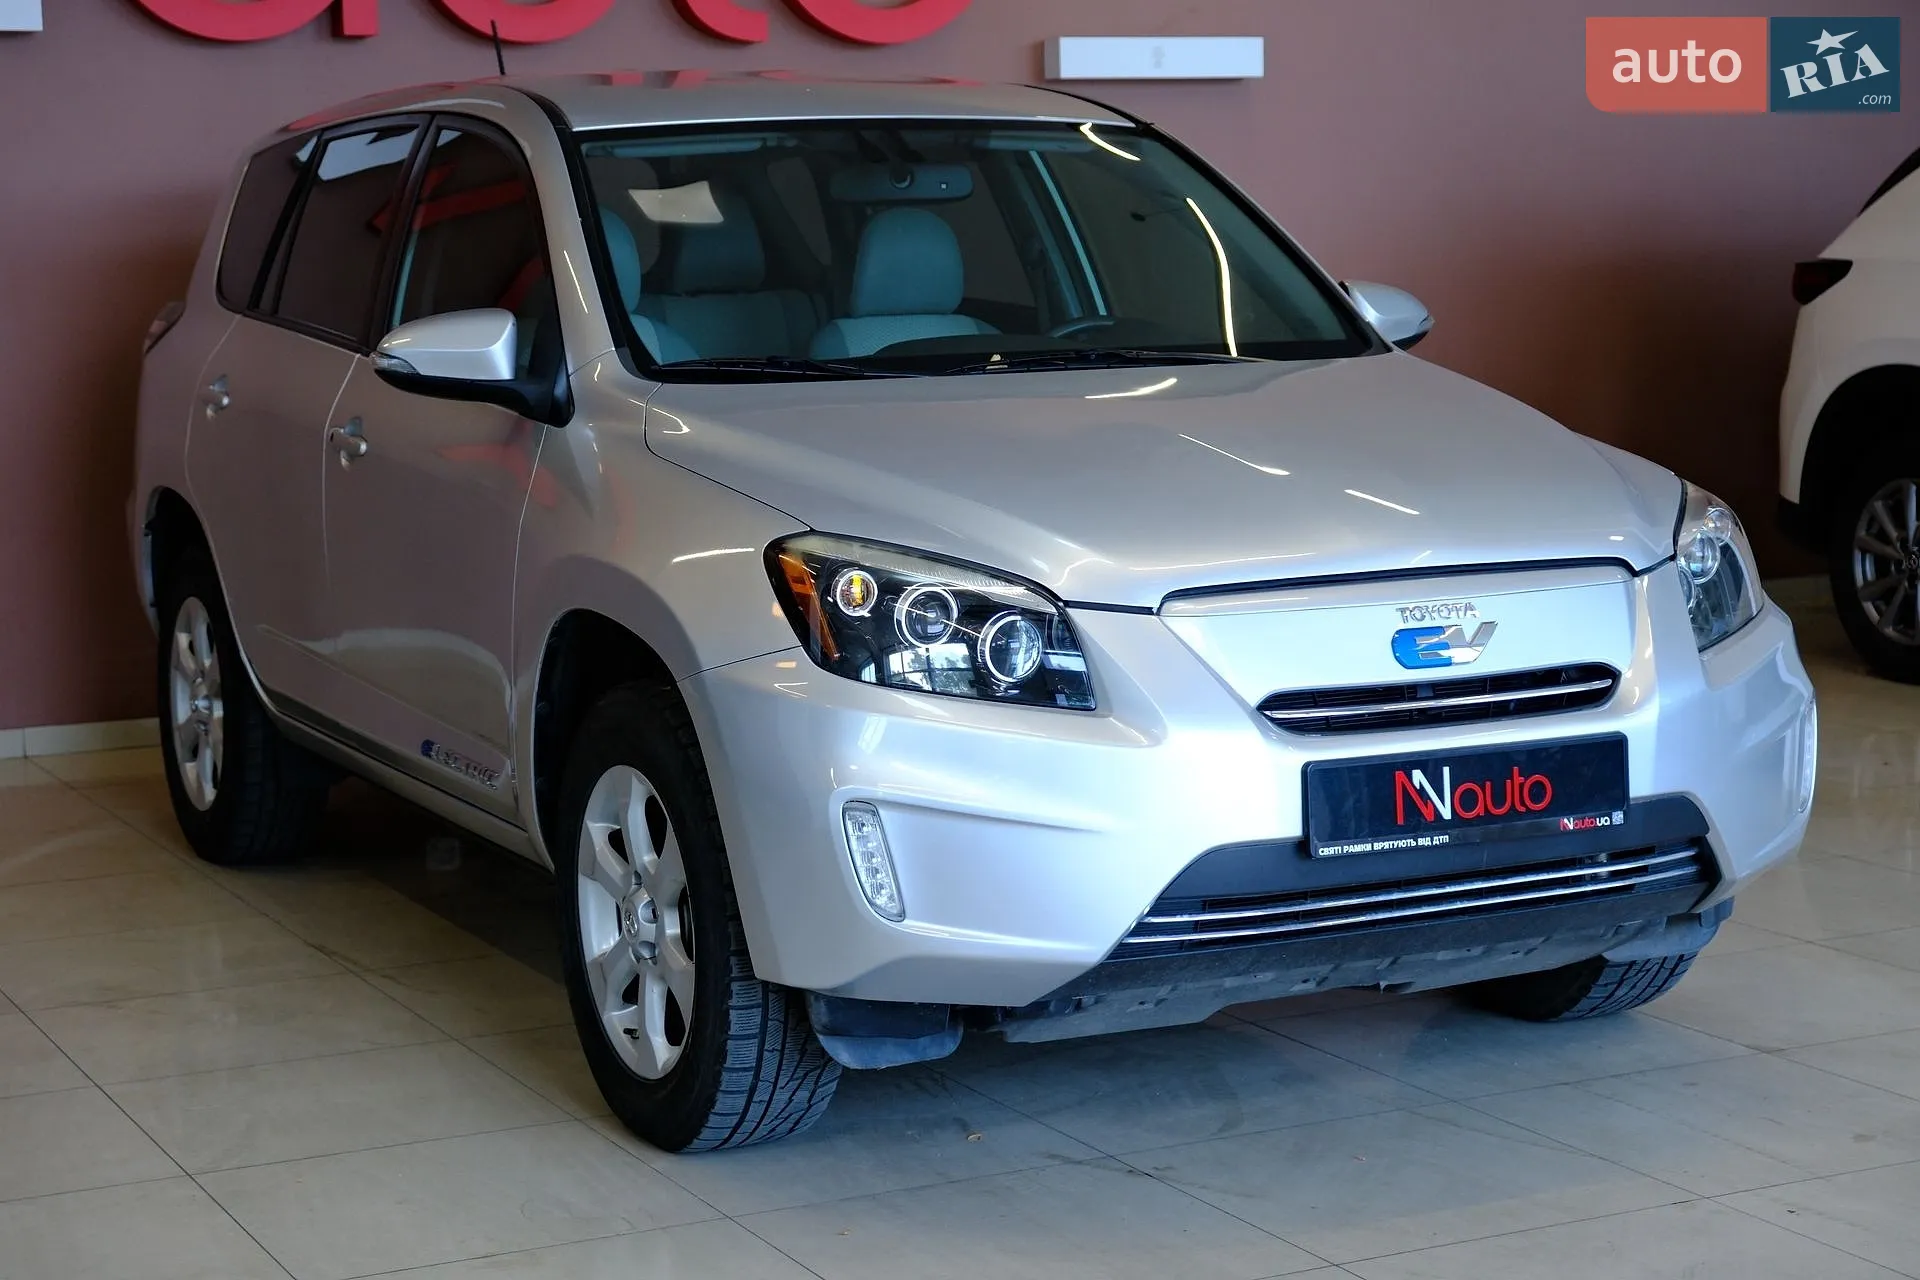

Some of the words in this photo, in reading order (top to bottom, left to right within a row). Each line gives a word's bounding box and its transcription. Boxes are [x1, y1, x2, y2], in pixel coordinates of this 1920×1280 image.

[1396, 601, 1479, 624] TOYOTA
[1391, 620, 1498, 669] EV
[1318, 846, 1341, 856] СВЯТІ
[1343, 843, 1372, 854] РАМКИ
[1373, 838, 1416, 851] ВРЯТУЮТЬ
[1417, 836, 1432, 846] ВІД
[1432, 834, 1449, 845] ДТП
